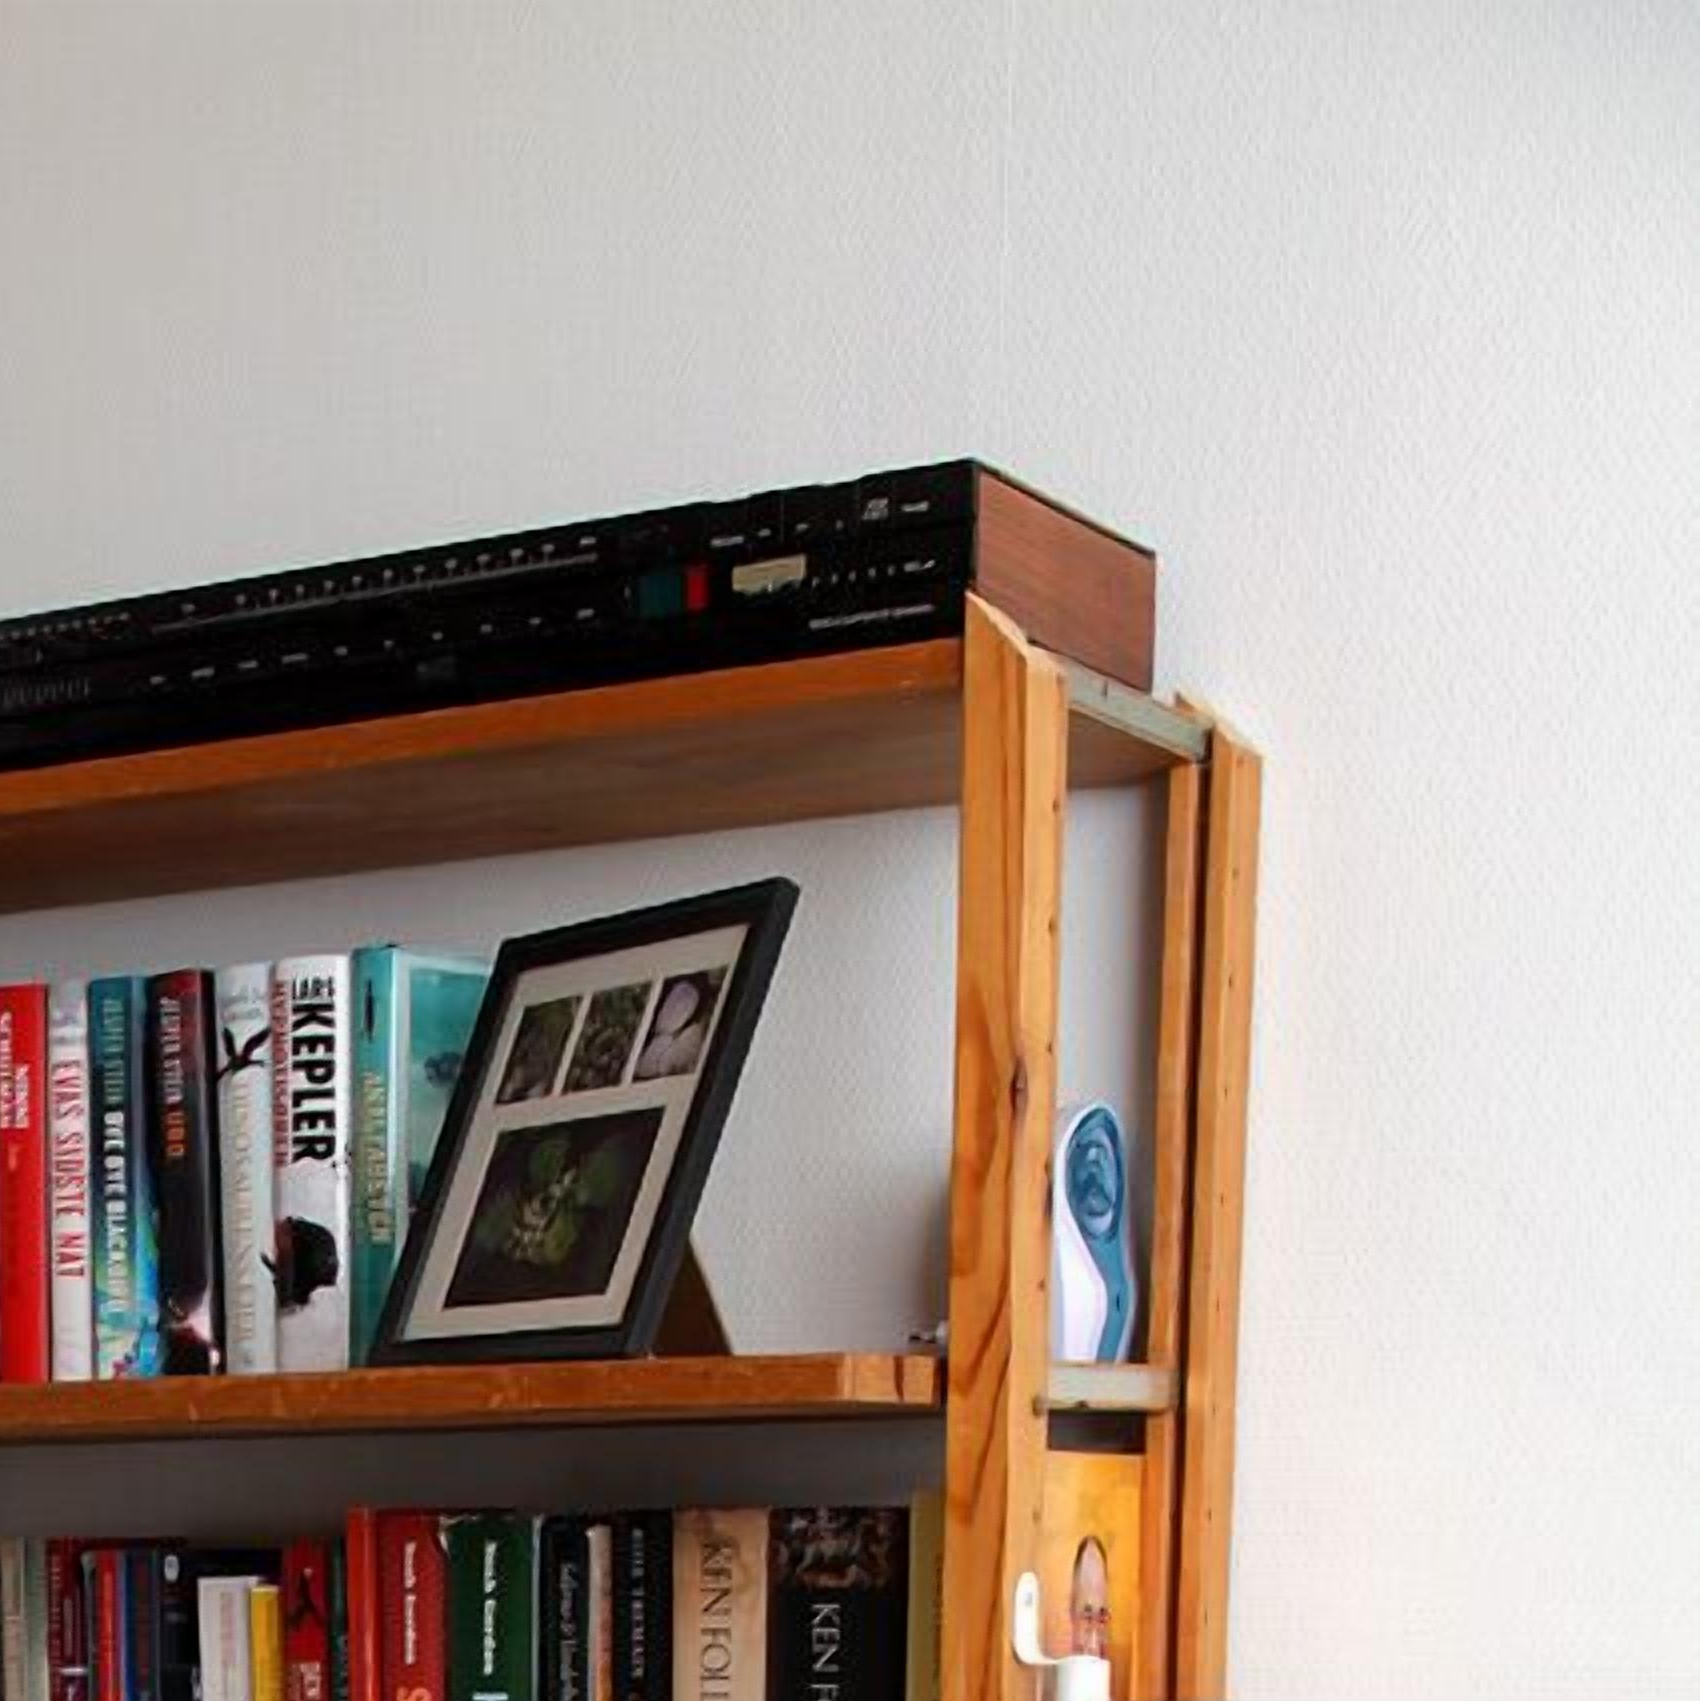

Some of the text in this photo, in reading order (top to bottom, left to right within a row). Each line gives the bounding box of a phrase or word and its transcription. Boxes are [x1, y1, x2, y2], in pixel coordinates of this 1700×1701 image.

[292, 1001, 336, 1163] KEPLER
[103, 1110, 125, 1148] BYE
[53, 1059, 86, 1281] EVAS SIDSTE NAT
[698, 1539, 732, 1615] KEN
[809, 1603, 841, 1674] KEN
